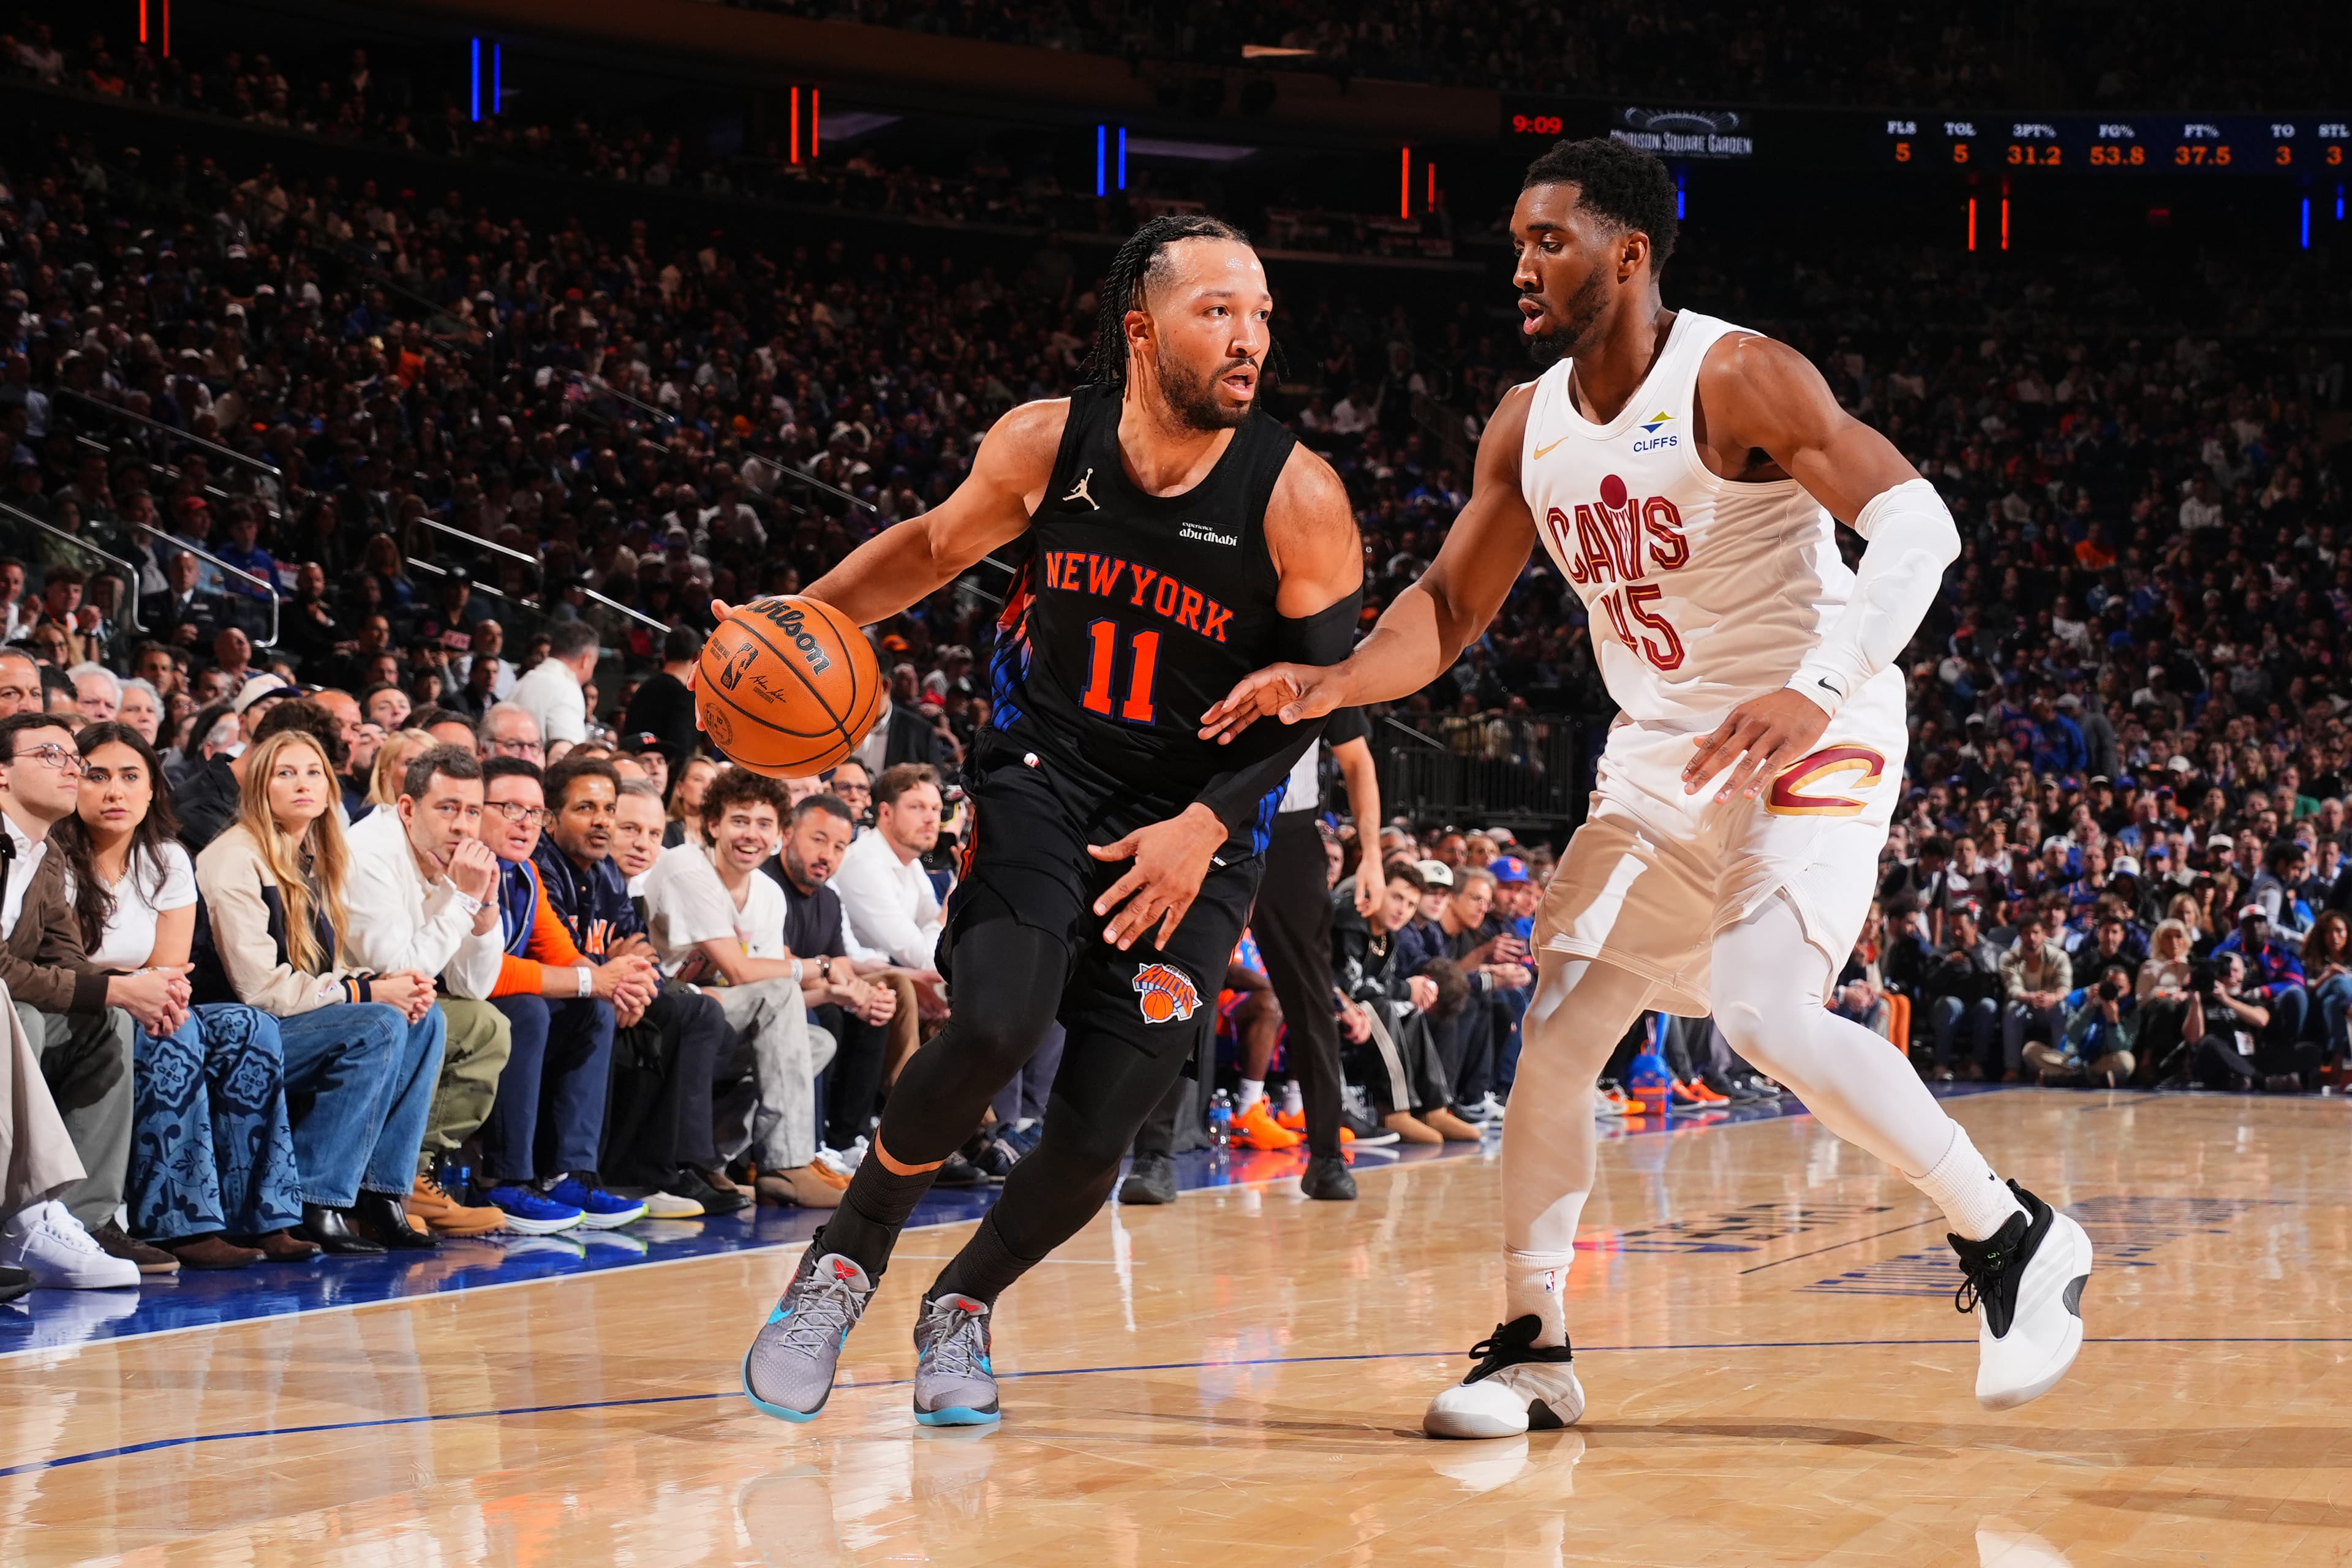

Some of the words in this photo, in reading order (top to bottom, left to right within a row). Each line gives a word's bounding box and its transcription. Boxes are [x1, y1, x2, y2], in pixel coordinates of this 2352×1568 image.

[1512, 115, 1562, 134] 9:09
[1887, 121, 1917, 135] FLS
[1944, 122, 1977, 136] TOL
[2013, 124, 2057, 138] 3PT%
[2099, 124, 2135, 138] FG%
[2184, 124, 2220, 138] FT%
[2271, 124, 2296, 137] TO
[2318, 124, 2350, 137] STL
[1662, 131, 1706, 153] SQUARE
[1708, 133, 1753, 154] GARDEN
[1896, 143, 1911, 162] 5
[1954, 143, 1969, 163] 5
[2007, 145, 2062, 165] 31.2
[2090, 145, 2145, 165] 53.8
[2175, 145, 2231, 165] 37.5
[2275, 146, 2292, 165] 3
[2326, 146, 2343, 165] 3
[1633, 435, 1678, 453] CLIFFS
[1179, 528, 1202, 540] abu
[1203, 532, 1238, 546] dhabi
[1182, 522, 1213, 531] experience
[1547, 494, 1691, 584] CAVS
[1044, 549, 1127, 598] NEW
[1128, 562, 1235, 644] YORK
[745, 599, 831, 676] Wilson
[1600, 583, 1686, 671] 45
[1079, 616, 1162, 726] 11
[1134, 964, 1196, 1018] KNICKS
